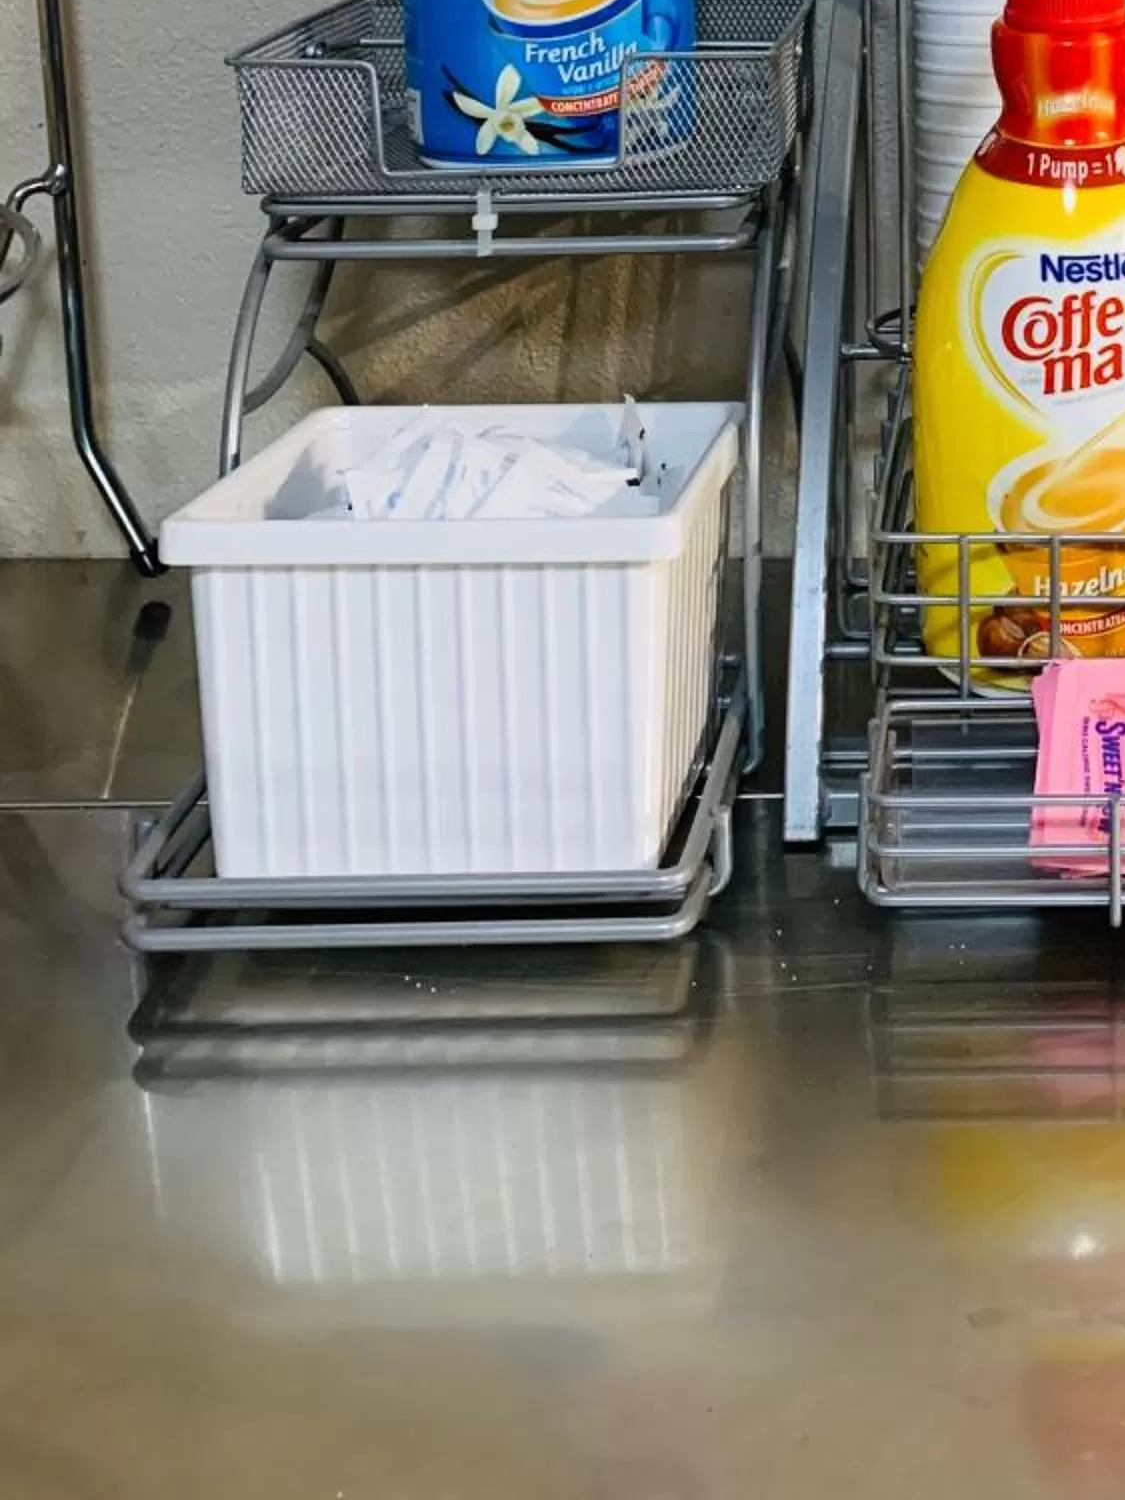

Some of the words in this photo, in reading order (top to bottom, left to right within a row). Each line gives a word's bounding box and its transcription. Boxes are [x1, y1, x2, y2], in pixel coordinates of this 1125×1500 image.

[525, 31, 606, 64] French
[1027, 153, 1034, 176] 1
[1039, 153, 1088, 186] Pump
